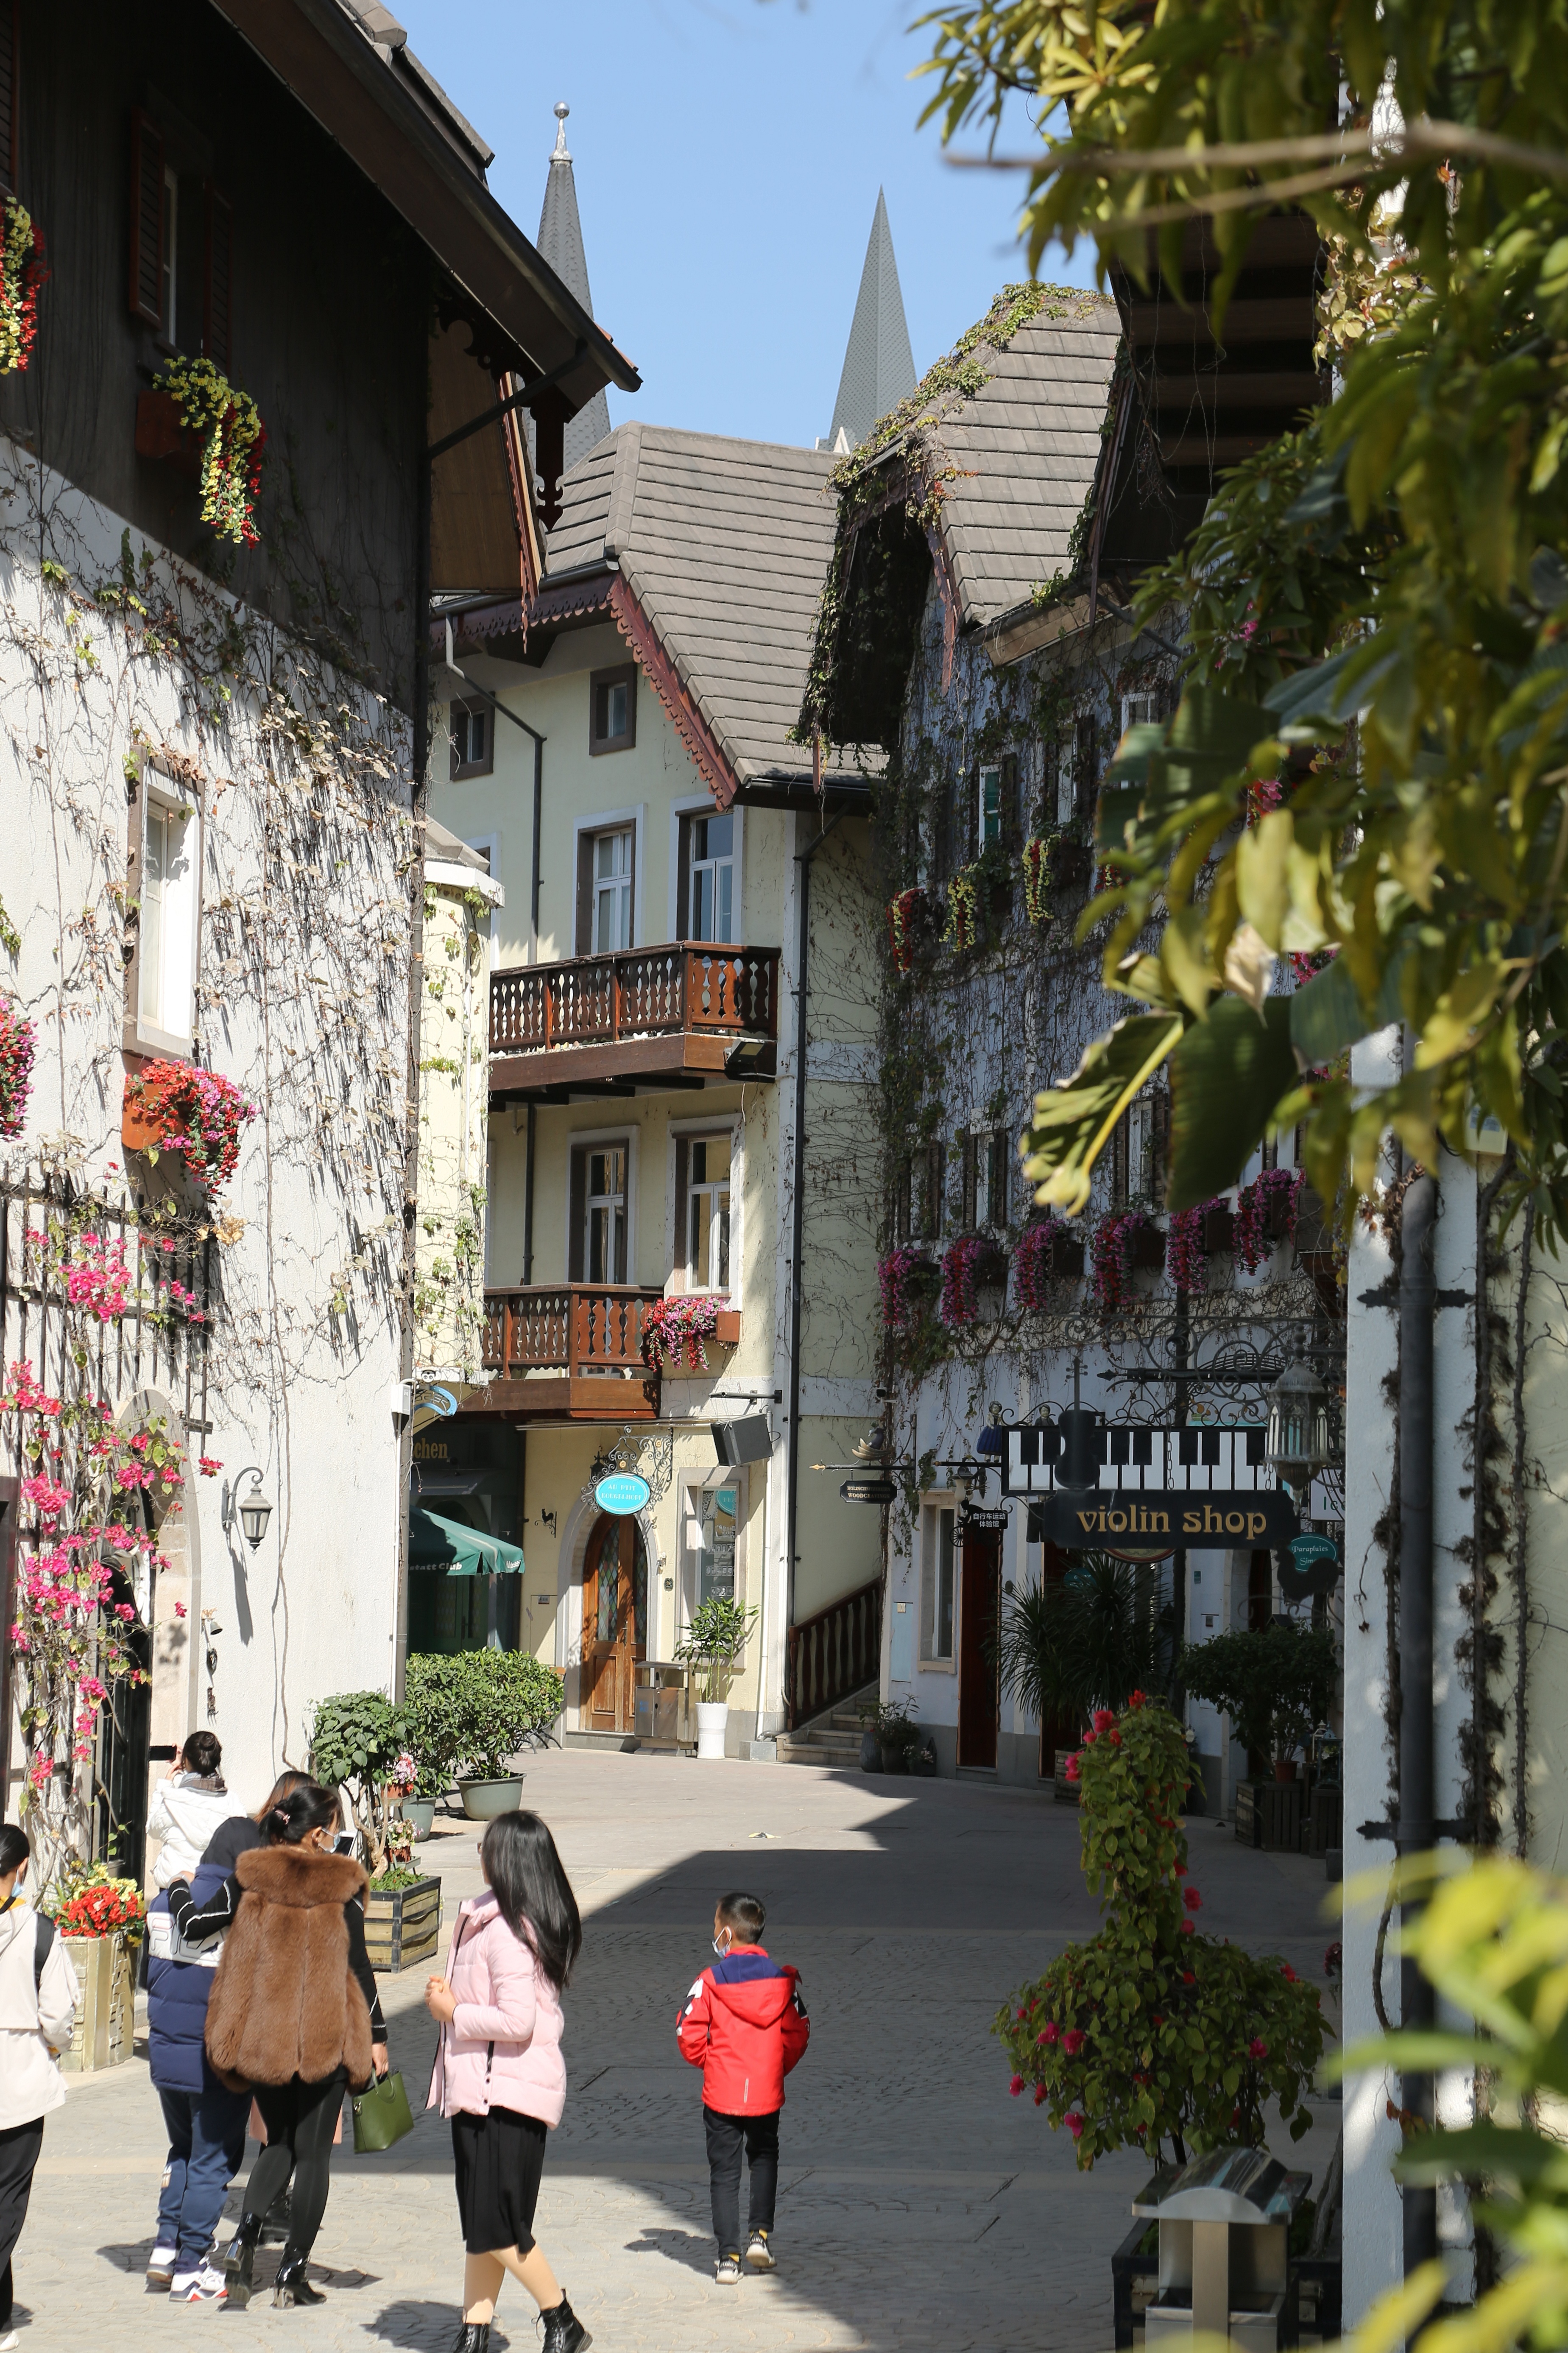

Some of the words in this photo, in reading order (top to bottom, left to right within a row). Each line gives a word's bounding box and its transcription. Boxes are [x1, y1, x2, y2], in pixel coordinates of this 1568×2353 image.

[413, 1437, 448, 1459] chen
[1077, 1504, 1171, 1532] violin
[1183, 1505, 1267, 1540] shop
[1292, 1545, 1328, 1554] Parapluies
[438, 1562, 463, 1570] Club
[1299, 1557, 1317, 1566] Sim
